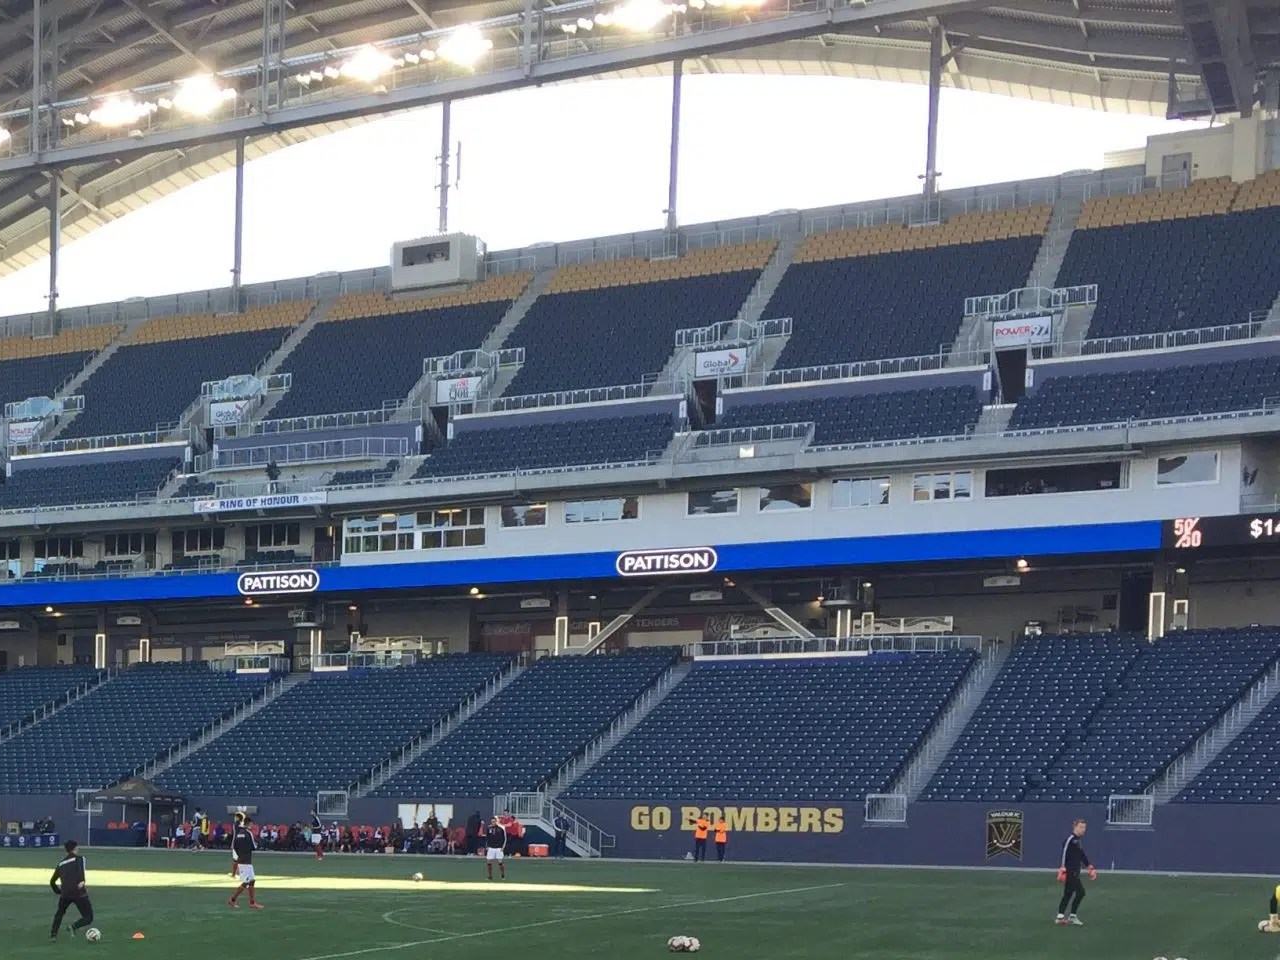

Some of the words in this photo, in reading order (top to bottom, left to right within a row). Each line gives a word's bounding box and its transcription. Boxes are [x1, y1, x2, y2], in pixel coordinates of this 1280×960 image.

[703, 360, 731, 369] Global
[220, 500, 243, 509] RING
[246, 498, 258, 507] OF
[261, 496, 299, 506] HONOUR
[624, 553, 708, 571] PATTISON
[244, 574, 313, 590] PATTISON
[631, 806, 671, 830] GO
[680, 807, 843, 833] BOMBERS
